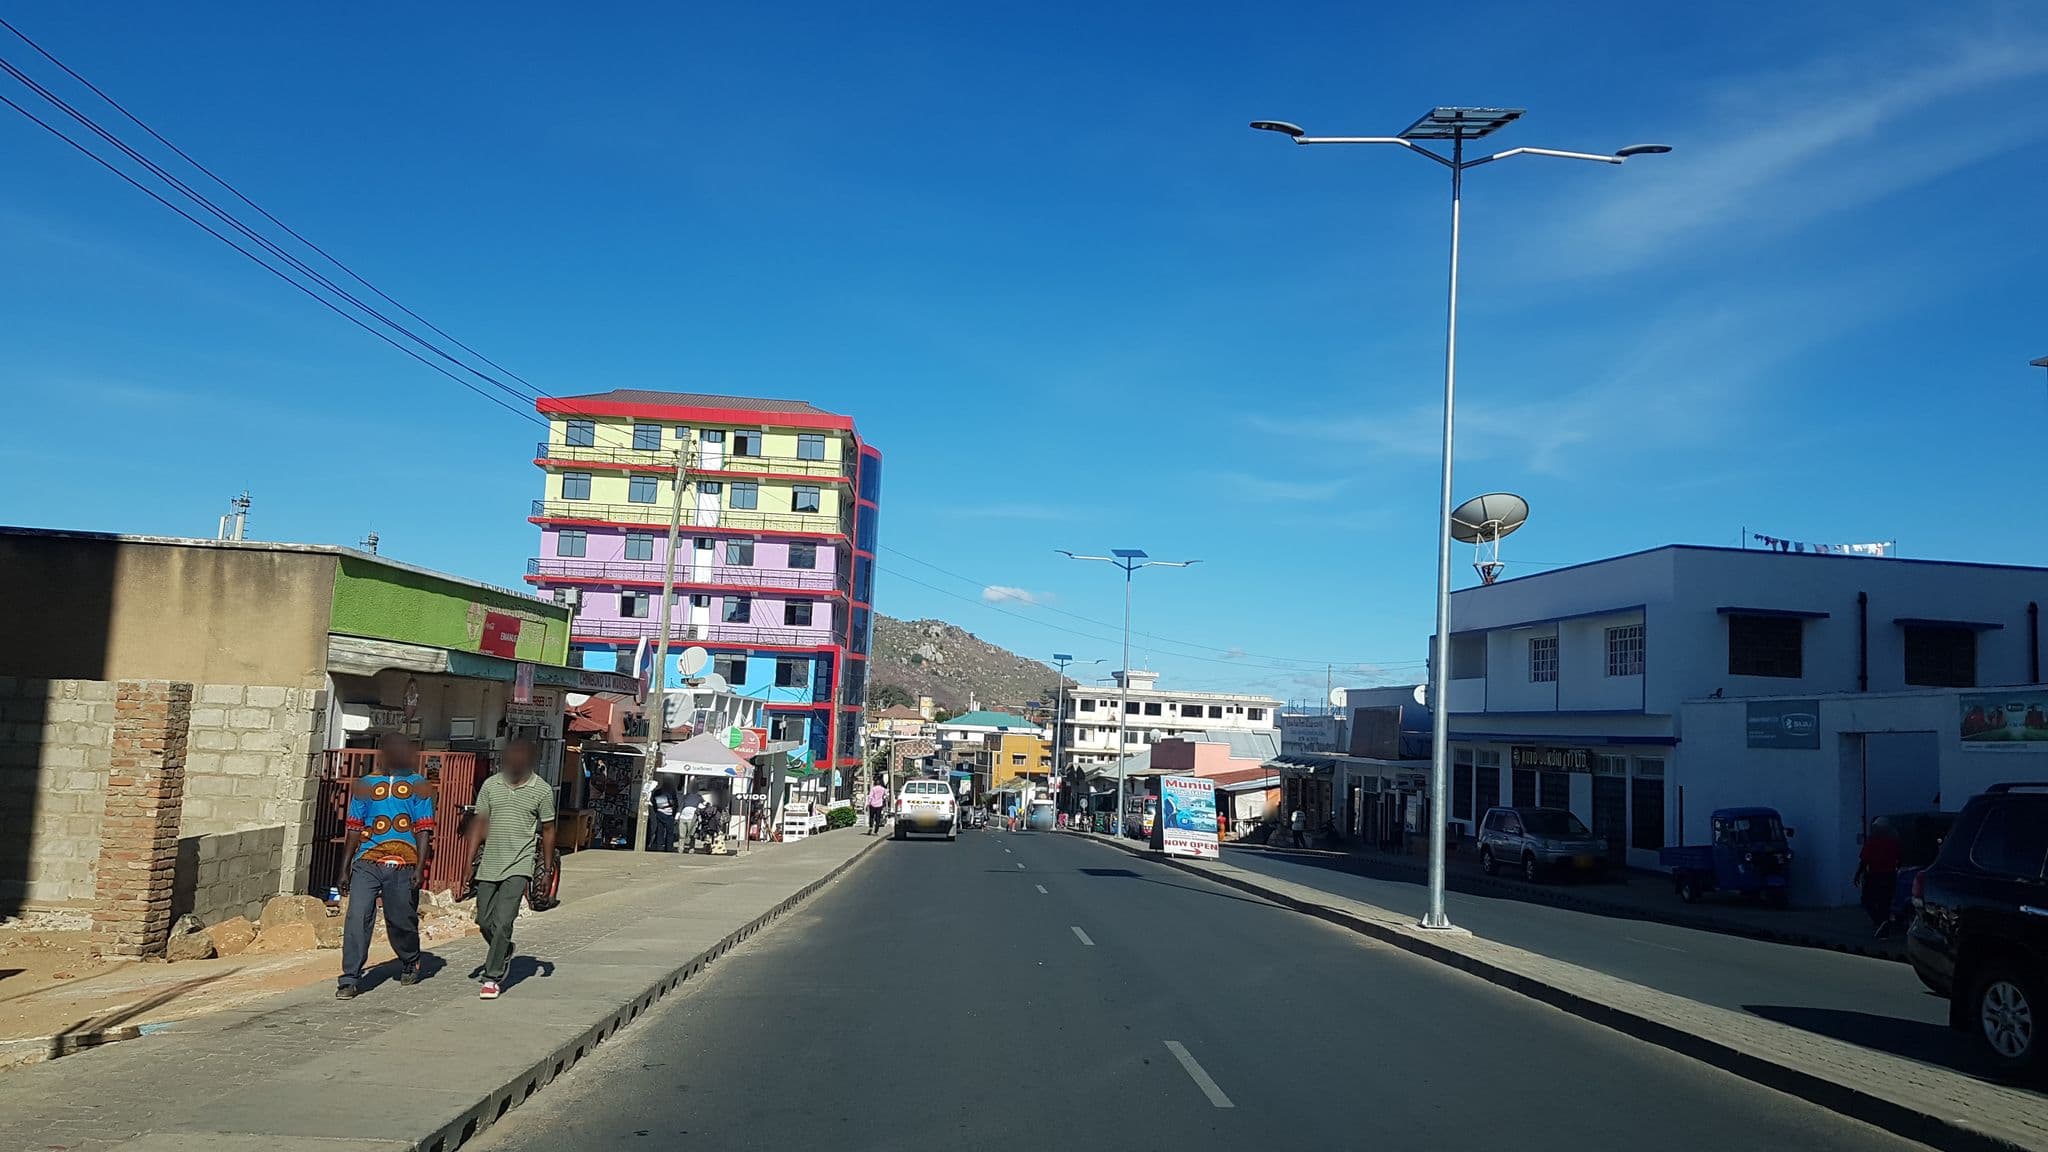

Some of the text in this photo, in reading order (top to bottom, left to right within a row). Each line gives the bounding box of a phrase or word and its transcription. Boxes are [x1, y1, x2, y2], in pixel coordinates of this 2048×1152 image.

[1165, 779, 1212, 791] Muniu
[1165, 839, 1188, 848] NOW
[1190, 841, 1218, 851] OPEN
